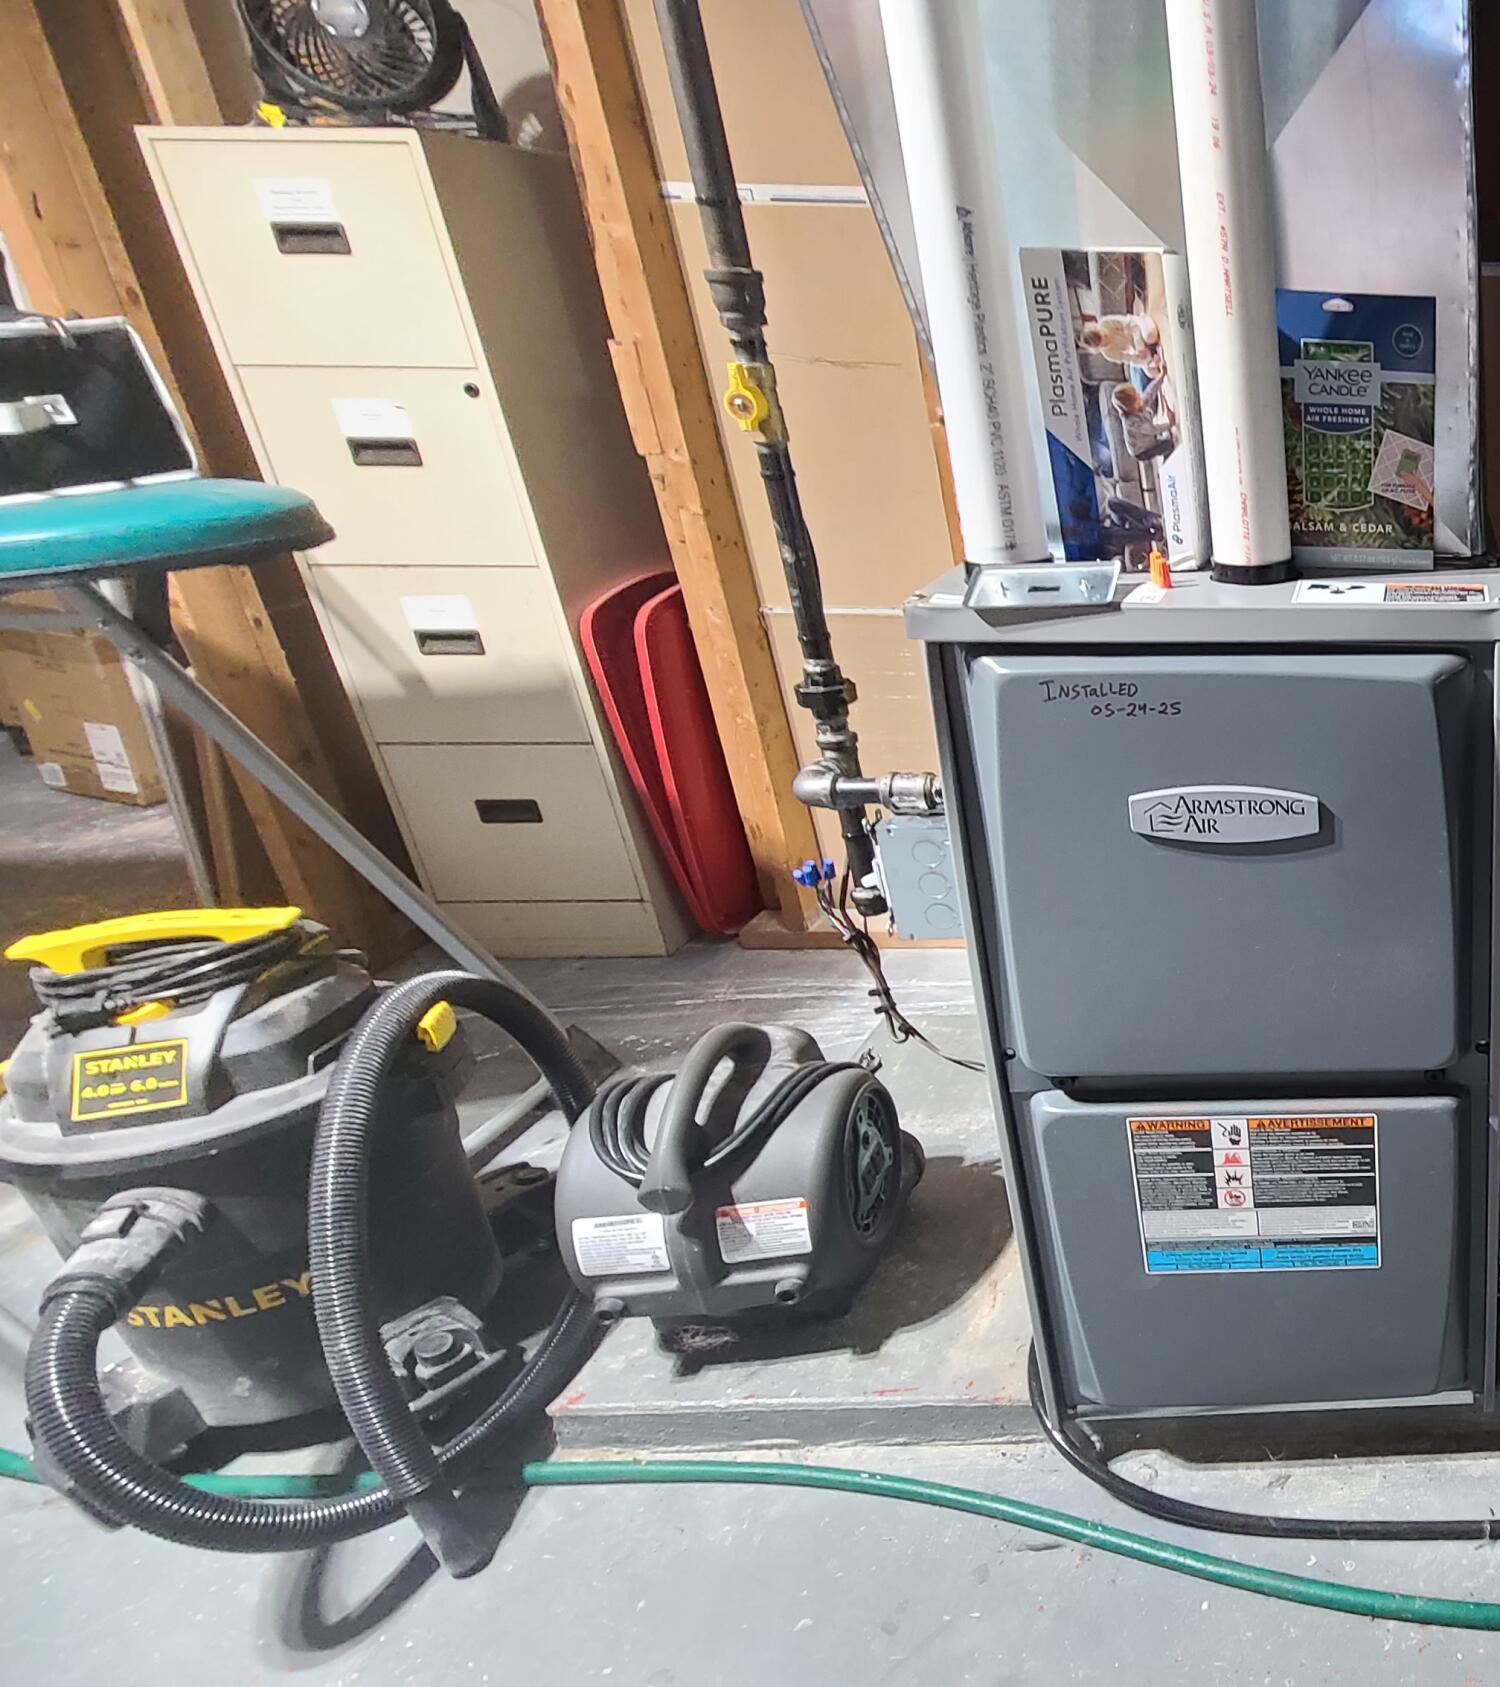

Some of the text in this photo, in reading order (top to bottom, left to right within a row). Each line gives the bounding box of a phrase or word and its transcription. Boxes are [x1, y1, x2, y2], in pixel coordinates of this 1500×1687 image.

[1031, 277, 1068, 417] PlasmaPURE
[1309, 406, 1339, 414] WHOLE
[1322, 416, 1370, 424] FRESHENER
[998, 483, 1015, 517] ASTM
[1289, 522, 1393, 533] ALSAM & CEDAR
[1091, 701, 1183, 718] 05-24-25
[1174, 795, 1306, 816] ARMSTRONG
[1184, 815, 1220, 834] AIR
[85, 1049, 177, 1076] STANLEY
[1147, 1118, 1366, 1130] WARNING AVERTISSEMENT
[128, 1270, 313, 1330] STANLEY
